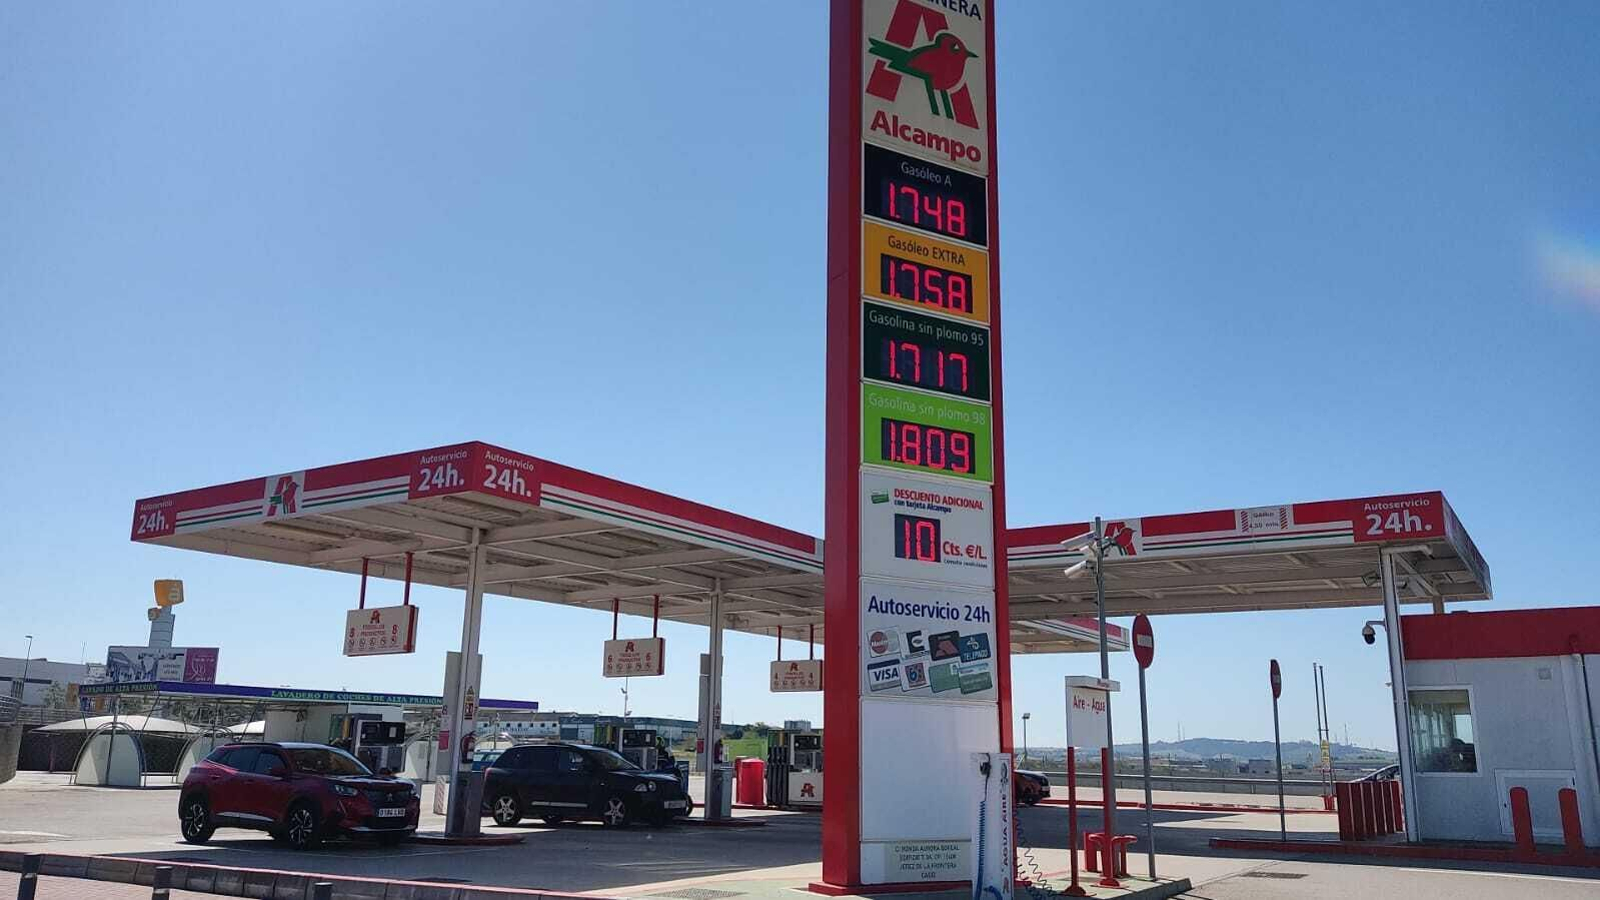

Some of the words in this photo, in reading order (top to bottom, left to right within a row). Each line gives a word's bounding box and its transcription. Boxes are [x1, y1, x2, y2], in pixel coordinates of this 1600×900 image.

[870, 110, 981, 162] Alcampo
[901, 162, 942, 183] Gasóleo
[944, 174, 952, 185] A
[889, 183, 965, 236] 1.748
[888, 235, 929, 257] Gasóleo
[932, 246, 966, 267] EXTRA
[890, 259, 966, 313] 1.758
[869, 309, 916, 331] Gasolina
[918, 321, 933, 336] sin
[936, 325, 968, 344] plomo
[970, 333, 985, 347] 95
[889, 339, 968, 393] 1.717
[869, 393, 916, 412] Gasolina
[918, 402, 934, 416] sin
[937, 406, 970, 423] plomo
[972, 412, 985, 425] 98
[420, 450, 467, 465] Autoservicio
[890, 421, 970, 474] 1.809
[485, 450, 534, 472] Autoservicio
[417, 462, 465, 491] 24h.
[483, 464, 532, 497] 24h.
[894, 488, 940, 504] DESCUENTO
[942, 496, 984, 510] ADICIONAL
[906, 500, 926, 511] tarjeta
[927, 504, 952, 514] Alcampo
[1364, 498, 1430, 512] Autoservicio
[137, 510, 168, 534] 24h.
[1366, 509, 1432, 535] 24h.
[904, 519, 936, 562] 10
[943, 541, 963, 556] Cts.
[966, 544, 987, 560] €/L.
[868, 595, 960, 621] Autoservicio
[964, 604, 990, 623] 24h
[392, 624, 398, 635] 8
[873, 667, 899, 681] VISA
[272, 690, 321, 699] LAVADERO
[323, 692, 333, 700] DE
[337, 693, 372, 702] COCHES
[373, 694, 385, 702] DE
[388, 696, 407, 704] ALTA
[1073, 694, 1085, 710] Aire
[1091, 698, 1105, 714] Agua
